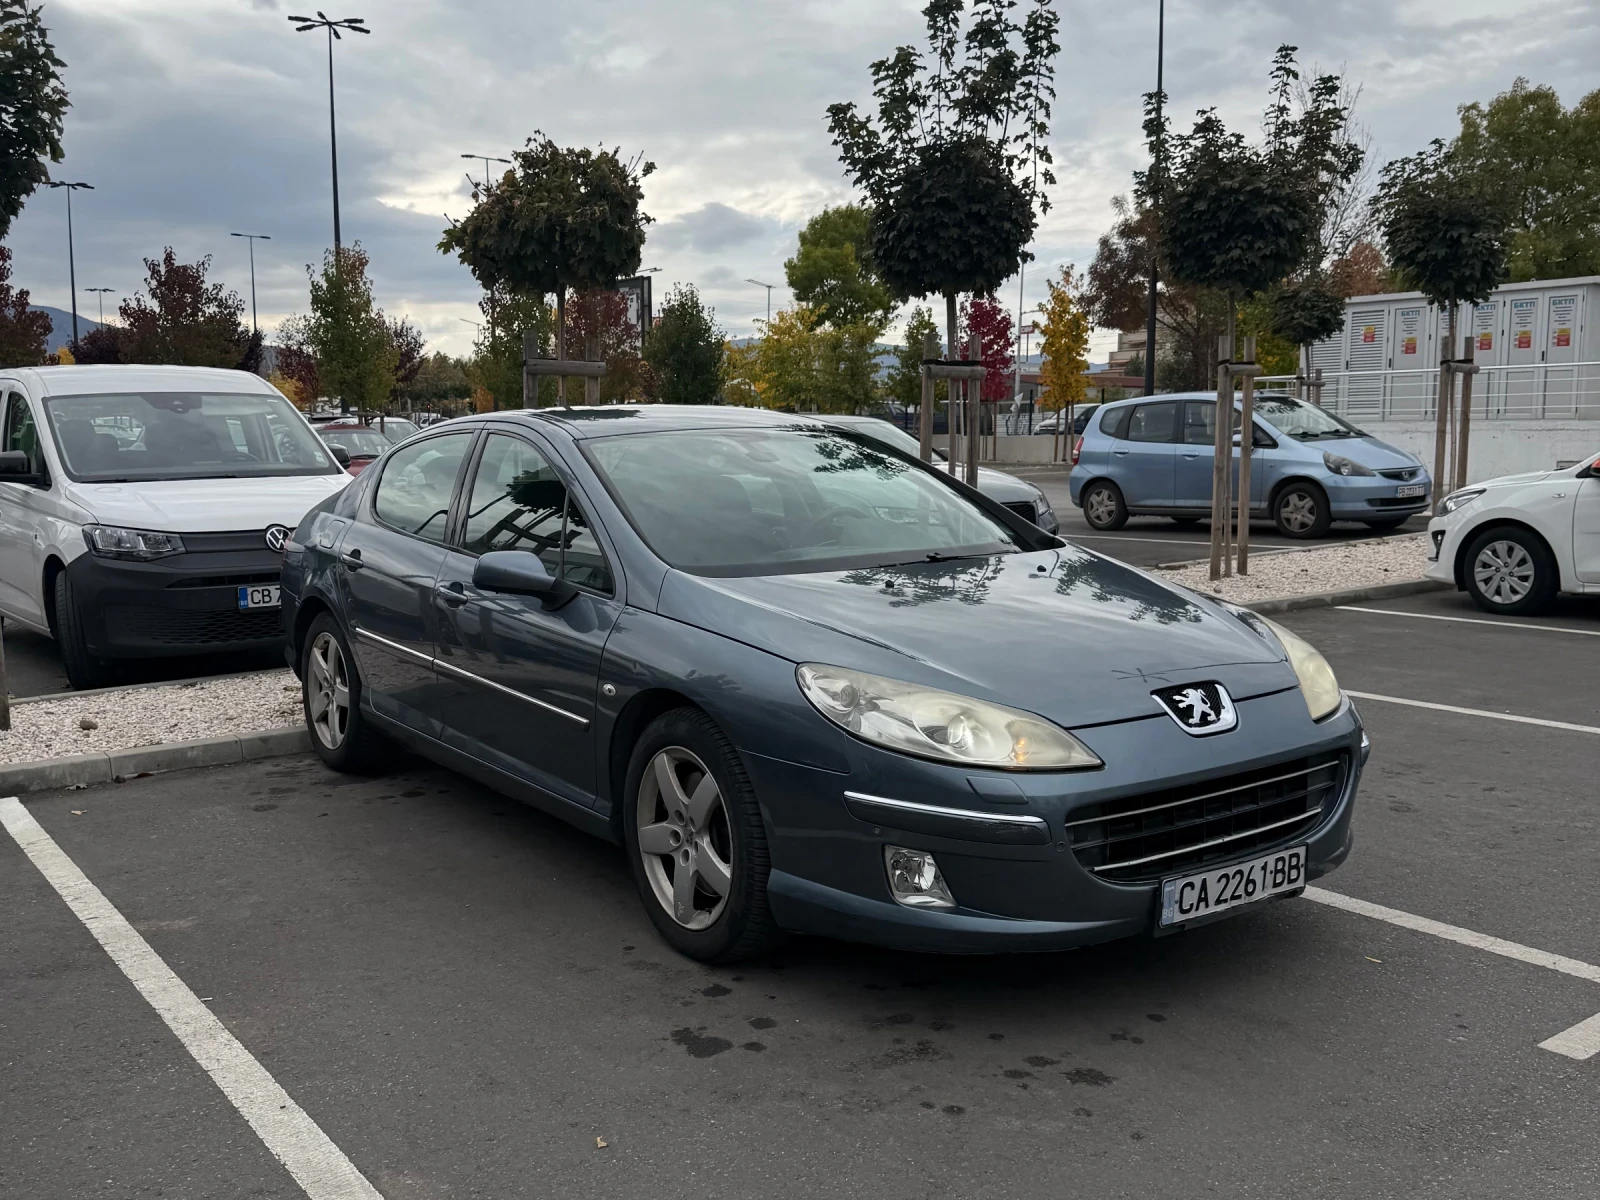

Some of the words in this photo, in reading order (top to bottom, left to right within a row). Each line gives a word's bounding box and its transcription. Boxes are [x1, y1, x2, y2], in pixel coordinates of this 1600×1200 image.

[250, 588, 272, 605] CB
[1179, 877, 1209, 914] CA
[1214, 861, 1268, 904] 2261
[1272, 852, 1301, 889] BB
[1163, 907, 1173, 918] BG
